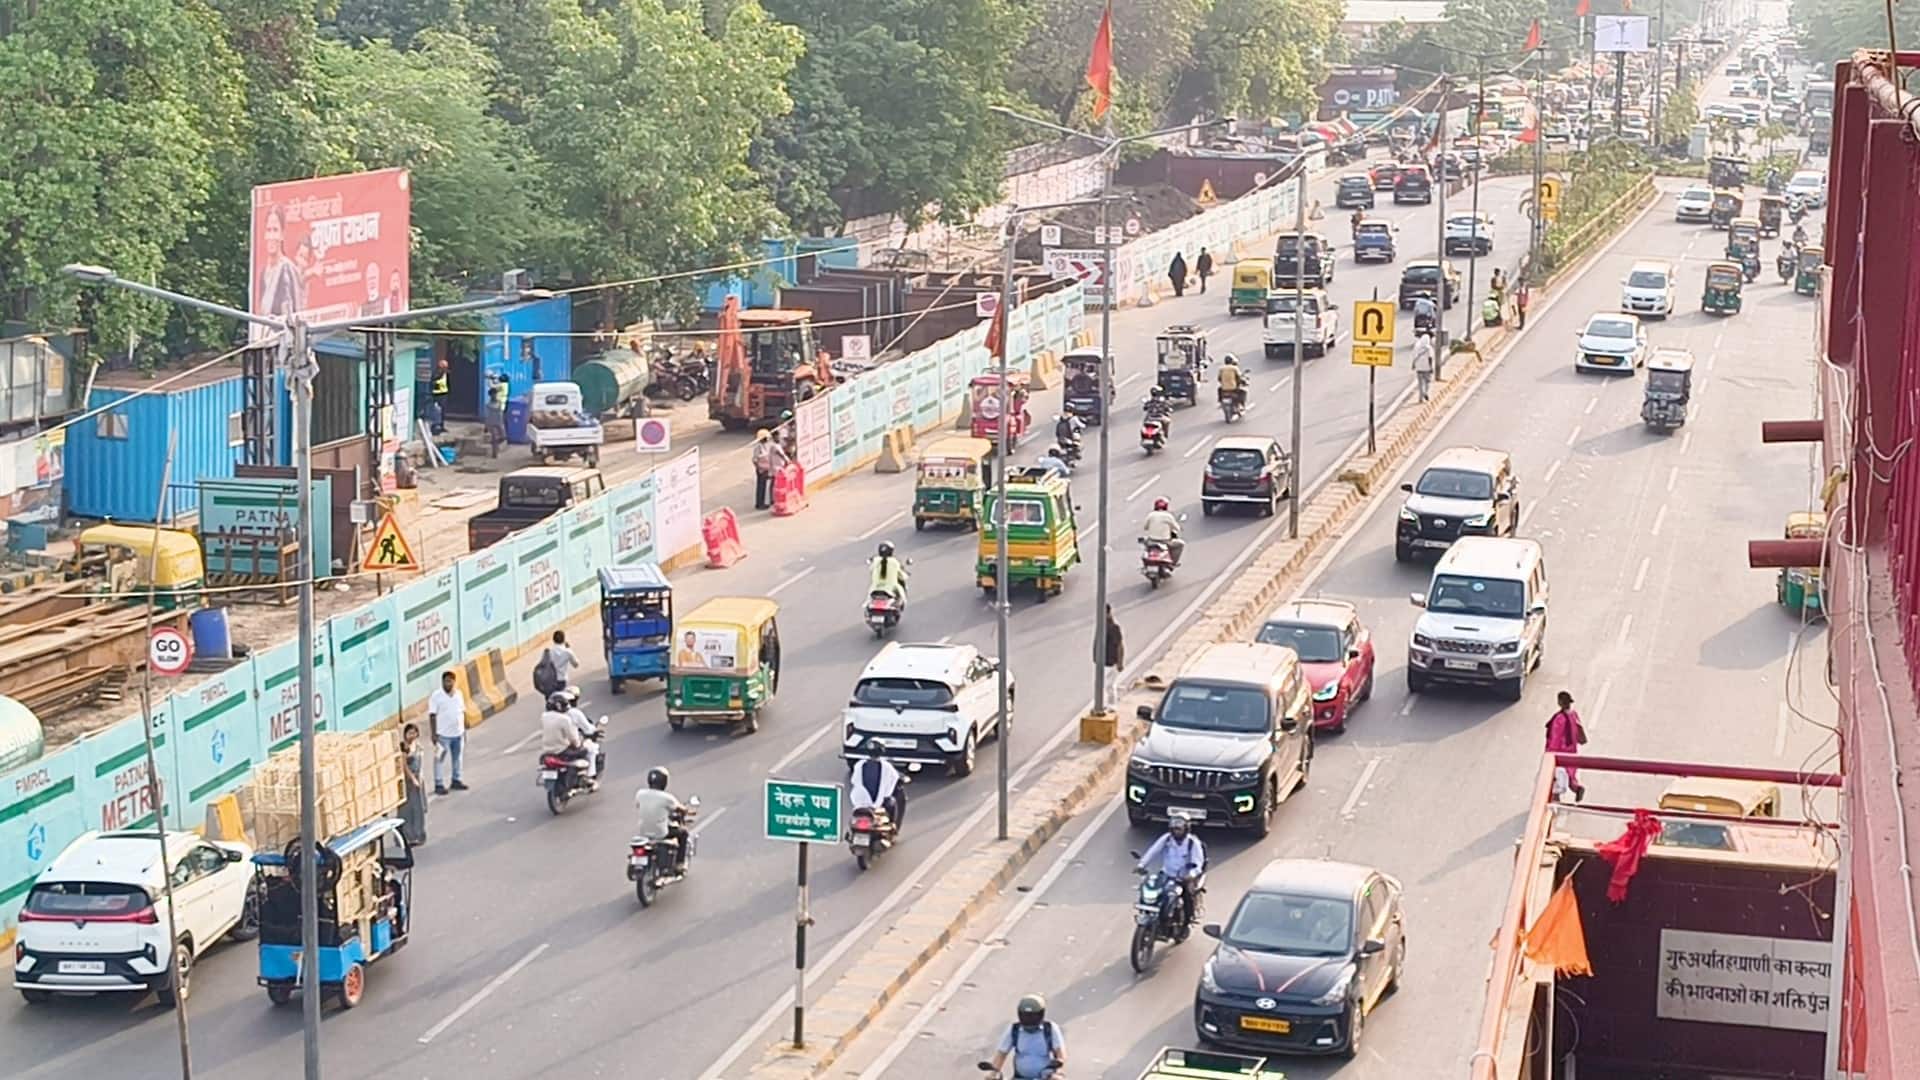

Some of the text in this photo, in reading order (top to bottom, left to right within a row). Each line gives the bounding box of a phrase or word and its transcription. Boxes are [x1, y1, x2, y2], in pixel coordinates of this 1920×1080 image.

[342, 212, 380, 243] राशन
[236, 510, 290, 521] PATNA
[525, 570, 559, 605] METRO
[156, 640, 180, 652] GO
[408, 626, 450, 668] METRO
[16, 768, 50, 795] PMRCL
[102, 778, 164, 832] METRO
[810, 795, 832, 809] पथ
[1774, 960, 1792, 975] का
[1664, 977, 1684, 999] की
[1749, 988, 1769, 1005] का
